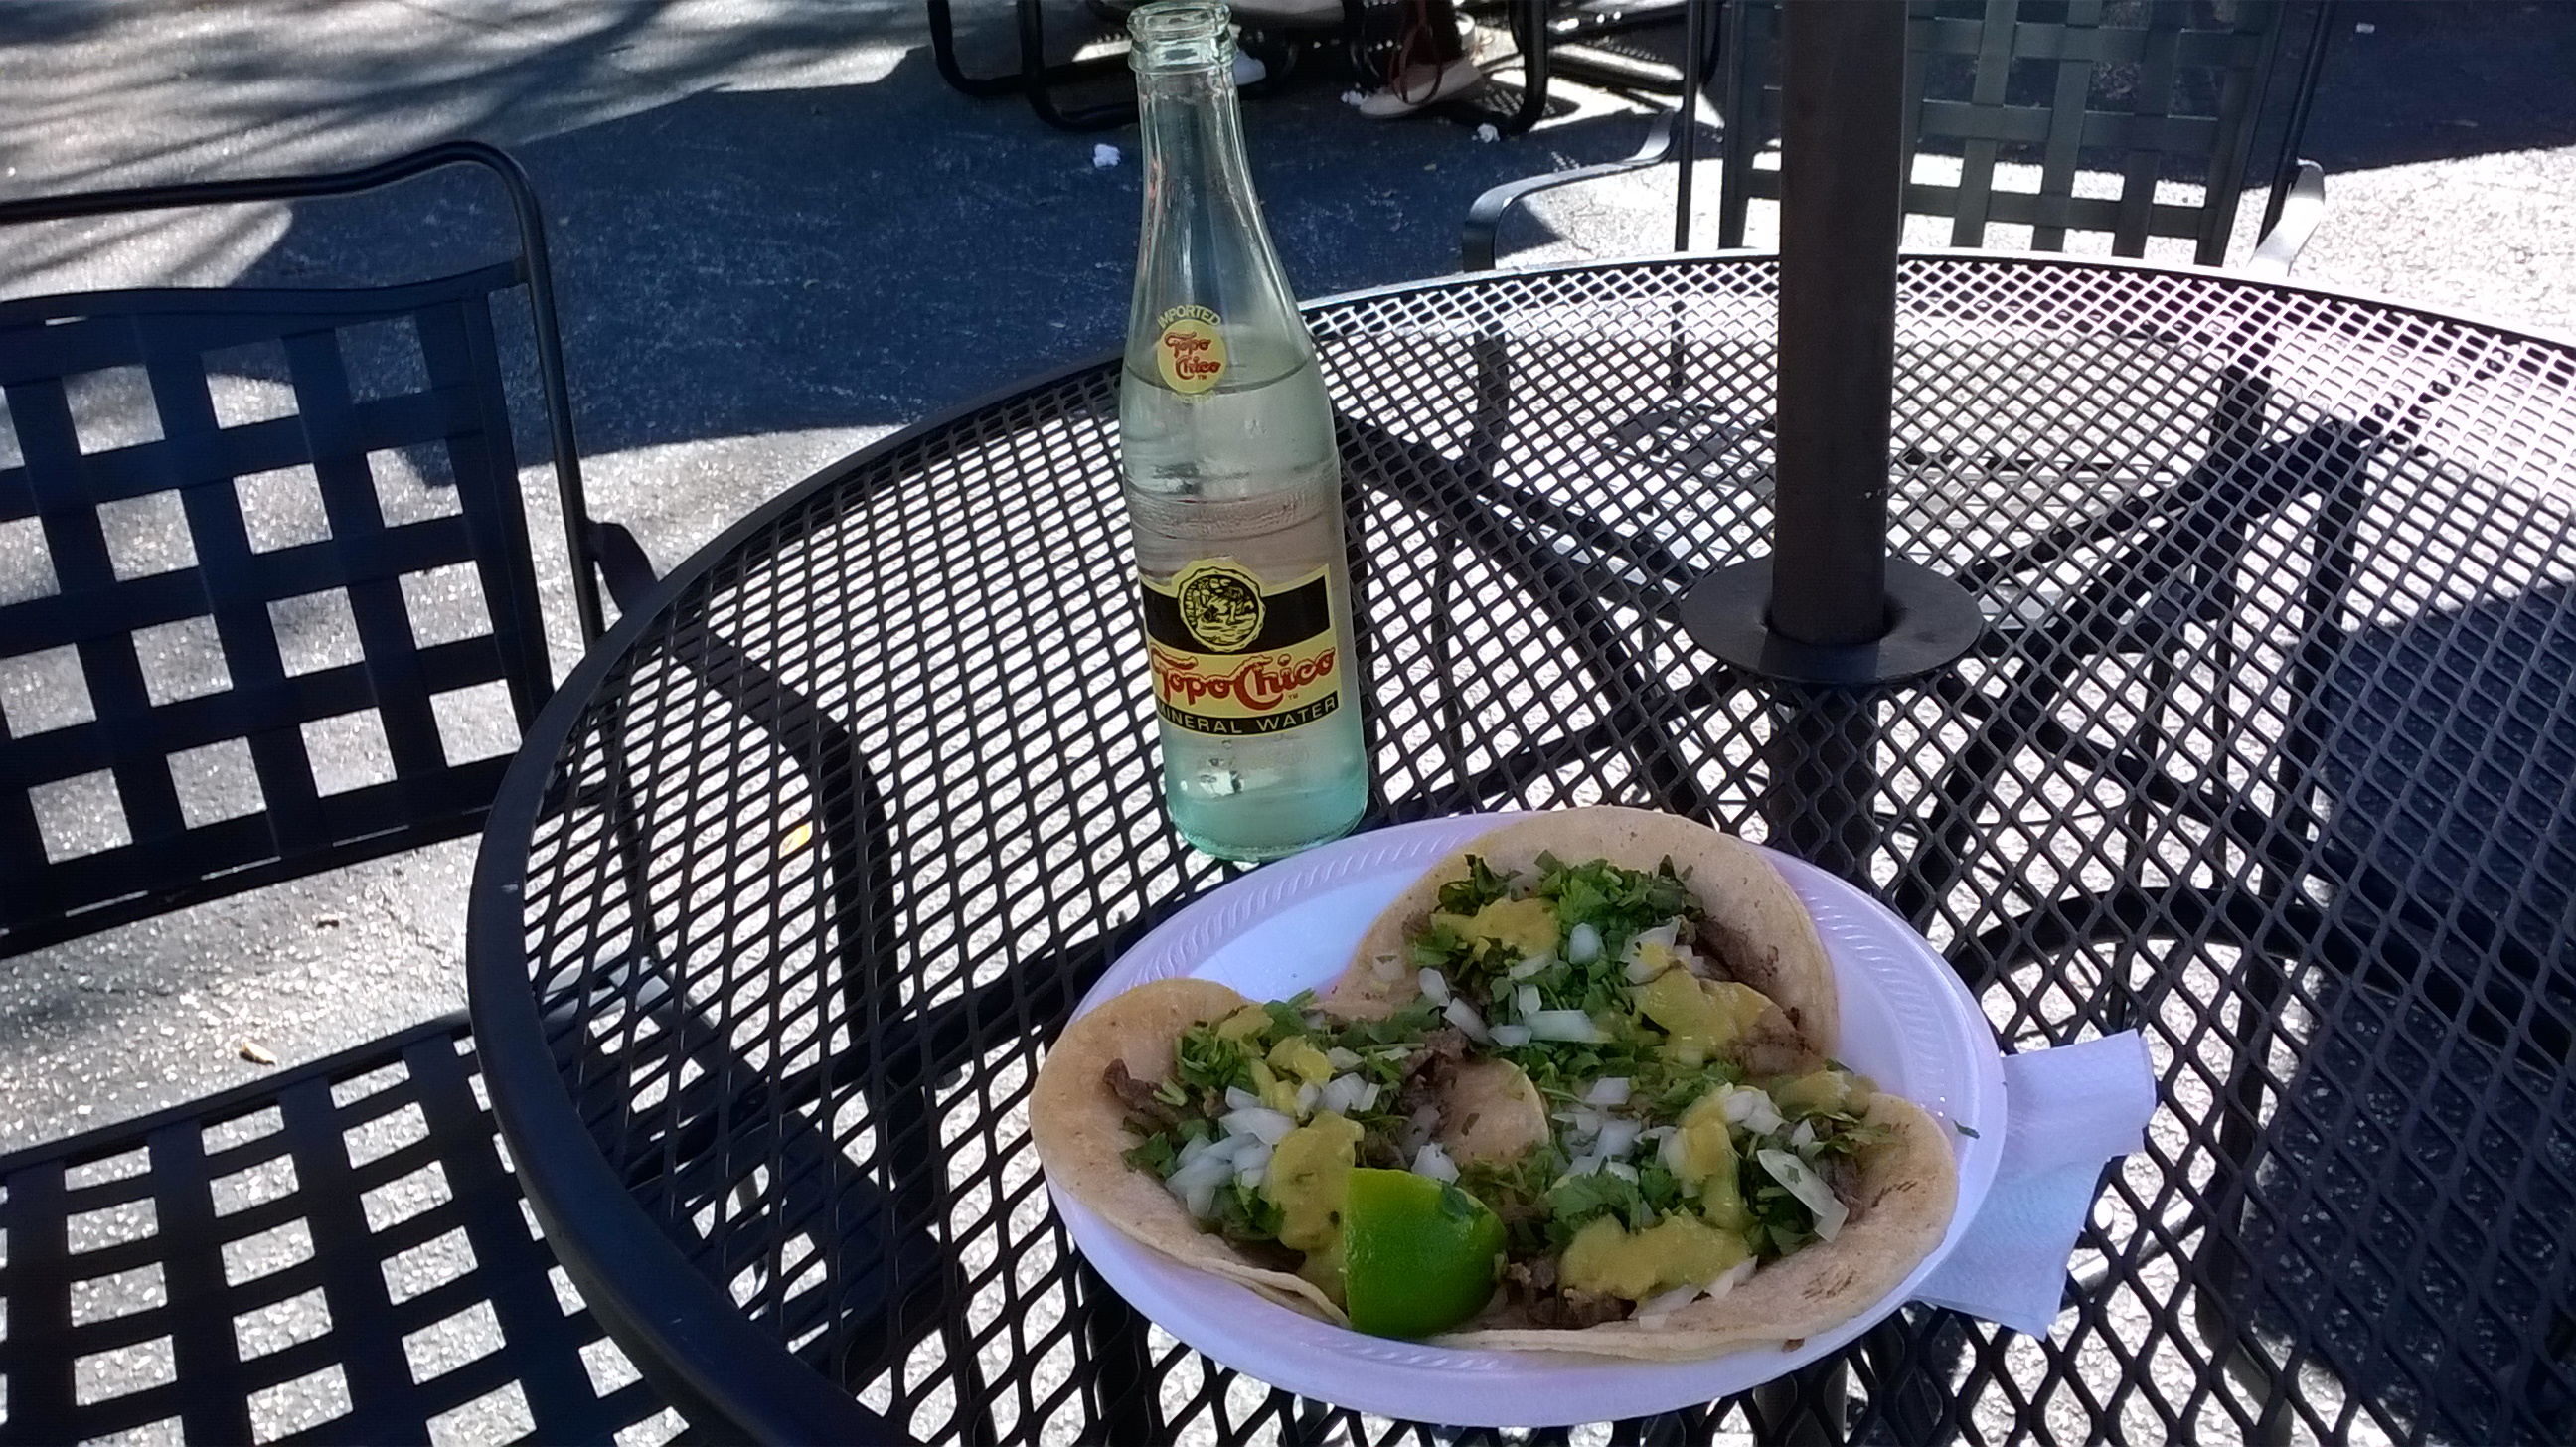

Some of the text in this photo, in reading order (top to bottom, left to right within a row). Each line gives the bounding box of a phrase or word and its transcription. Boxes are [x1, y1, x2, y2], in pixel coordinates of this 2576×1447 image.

[1158, 304, 1221, 329] IMPORTED
[1164, 331, 1211, 358] Topo
[1175, 355, 1221, 380] Chico
[1158, 697, 1336, 734] MINERAL WATER
